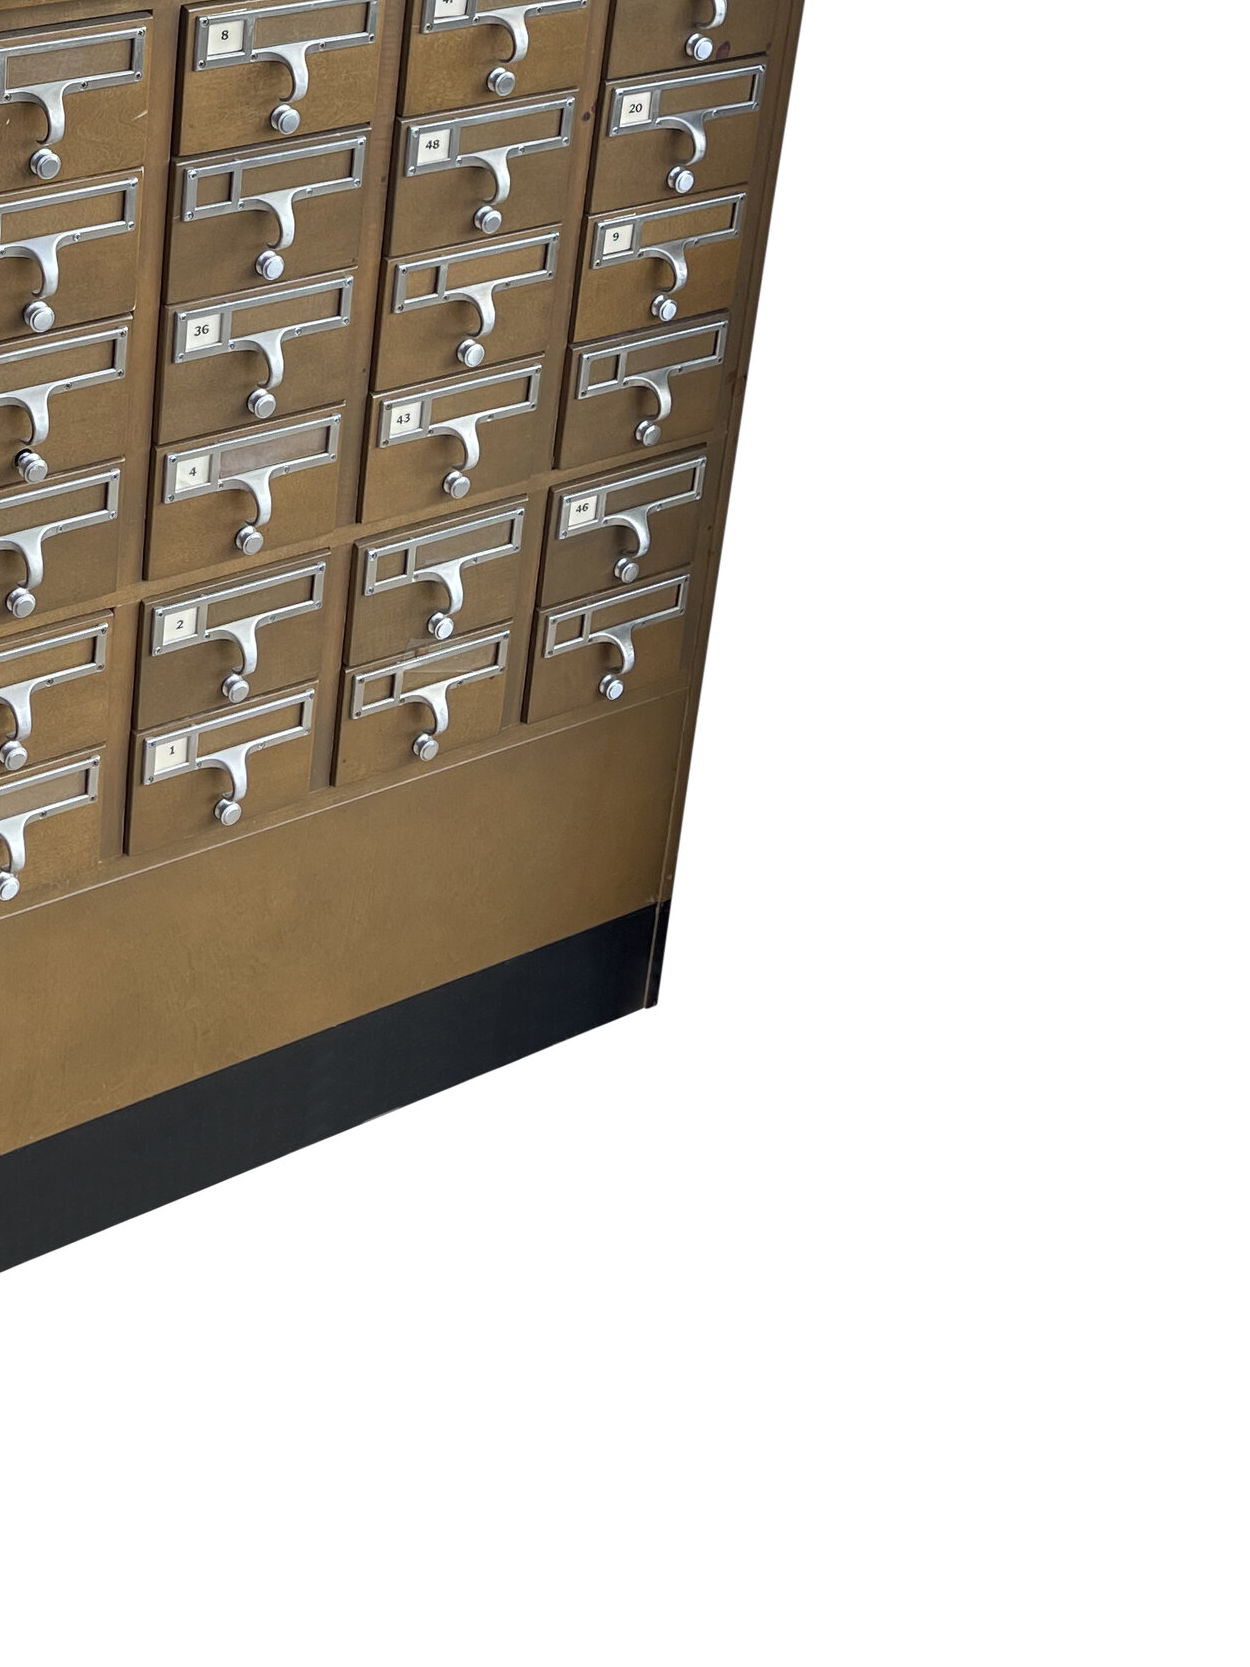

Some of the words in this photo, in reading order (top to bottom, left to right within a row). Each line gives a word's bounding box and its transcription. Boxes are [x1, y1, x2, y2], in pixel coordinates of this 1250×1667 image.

[221, 30, 229, 41] 8
[628, 103, 643, 114] 20
[425, 139, 440, 150] 48
[612, 232, 620, 242] 9
[194, 324, 210, 337] 36
[396, 413, 411, 425] 43
[189, 467, 197, 477] 4
[575, 502, 590, 514] 46
[176, 619, 184, 630] 2
[170, 745, 175, 755] 1
